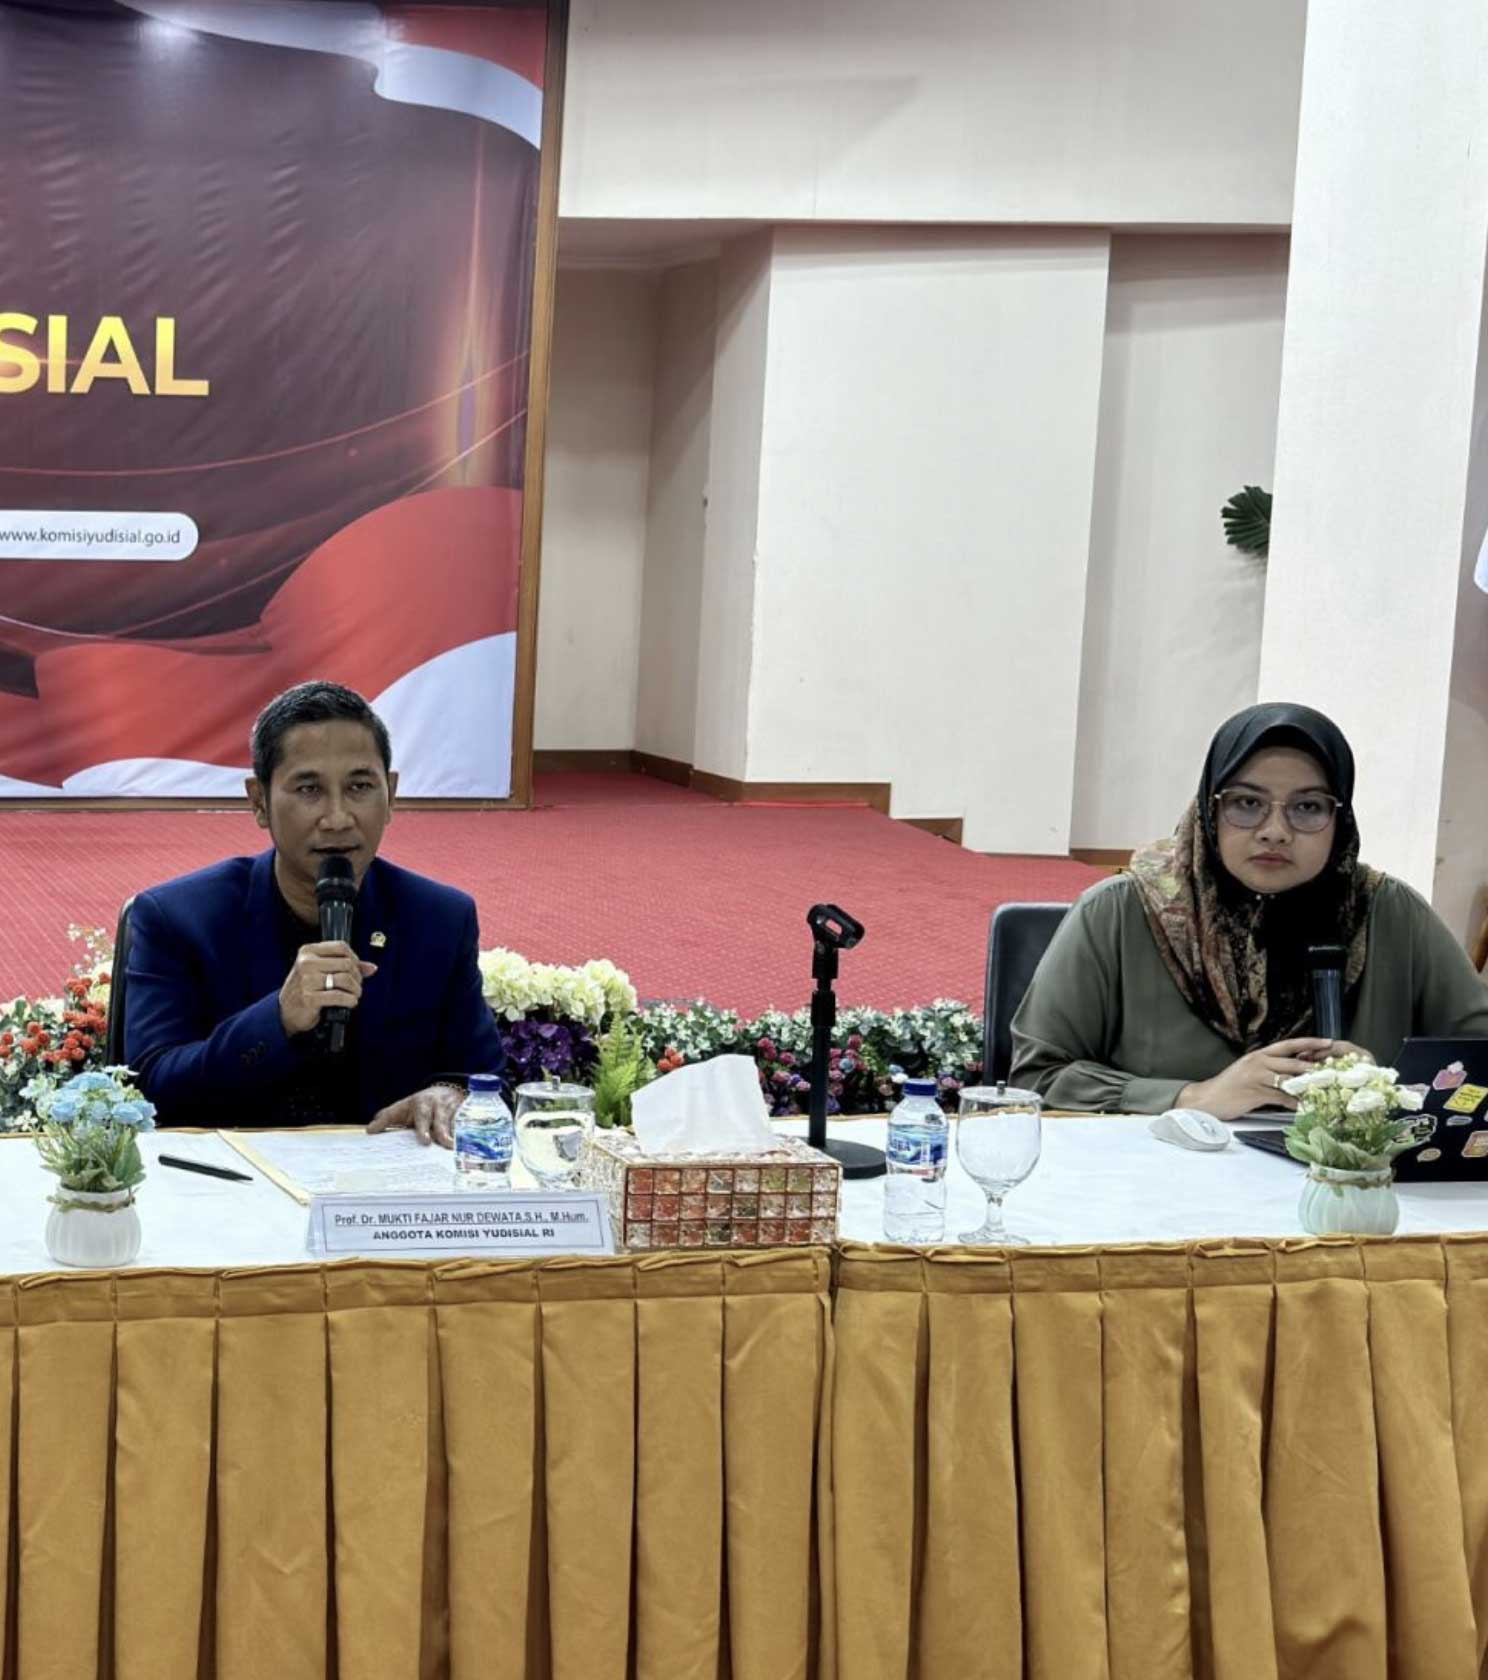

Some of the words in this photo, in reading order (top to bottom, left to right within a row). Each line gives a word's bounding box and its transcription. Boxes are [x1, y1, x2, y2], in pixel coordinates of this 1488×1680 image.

[378, 1213, 412, 1224] MUKTI
[414, 1212, 449, 1223] FAJAR
[451, 1212, 474, 1223] NUR
[373, 1230, 433, 1240] ANGGOTA
[436, 1229, 479, 1239] KOMISI
[482, 1228, 540, 1238] YUDISIAL
[542, 1228, 555, 1238] RI
